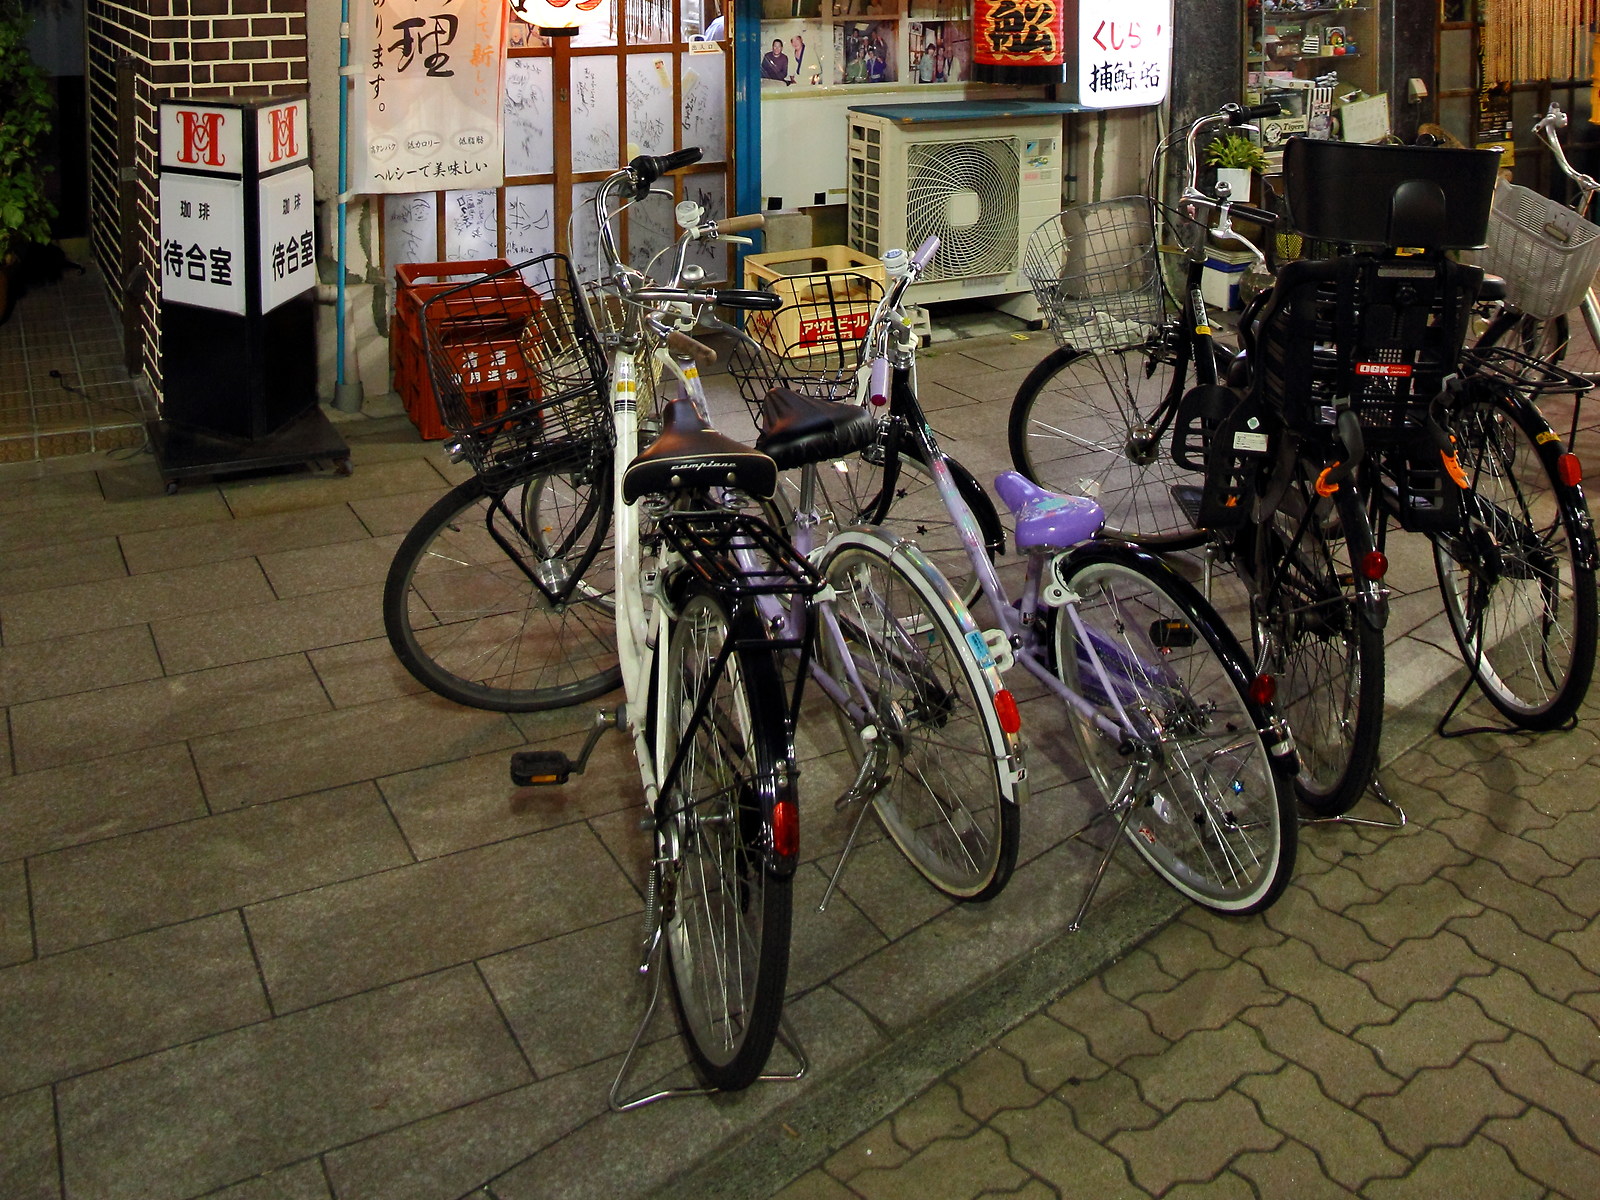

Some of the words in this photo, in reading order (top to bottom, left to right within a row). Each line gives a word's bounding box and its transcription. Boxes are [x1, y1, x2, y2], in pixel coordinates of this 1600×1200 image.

[1089, 60, 1161, 93] 捕鯨船
[1283, 122, 1304, 131] Tigers
[407, 140, 440, 150] 低カロリー
[374, 160, 488, 181] ヘルシーで美味しい
[180, 200, 211, 220] 珈琲
[164, 238, 232, 286] 待合室
[272, 230, 314, 281] 待合室
[802, 315, 868, 335] アサヒビール
[462, 350, 506, 368] 清酒
[1360, 365, 1389, 373] OGK
